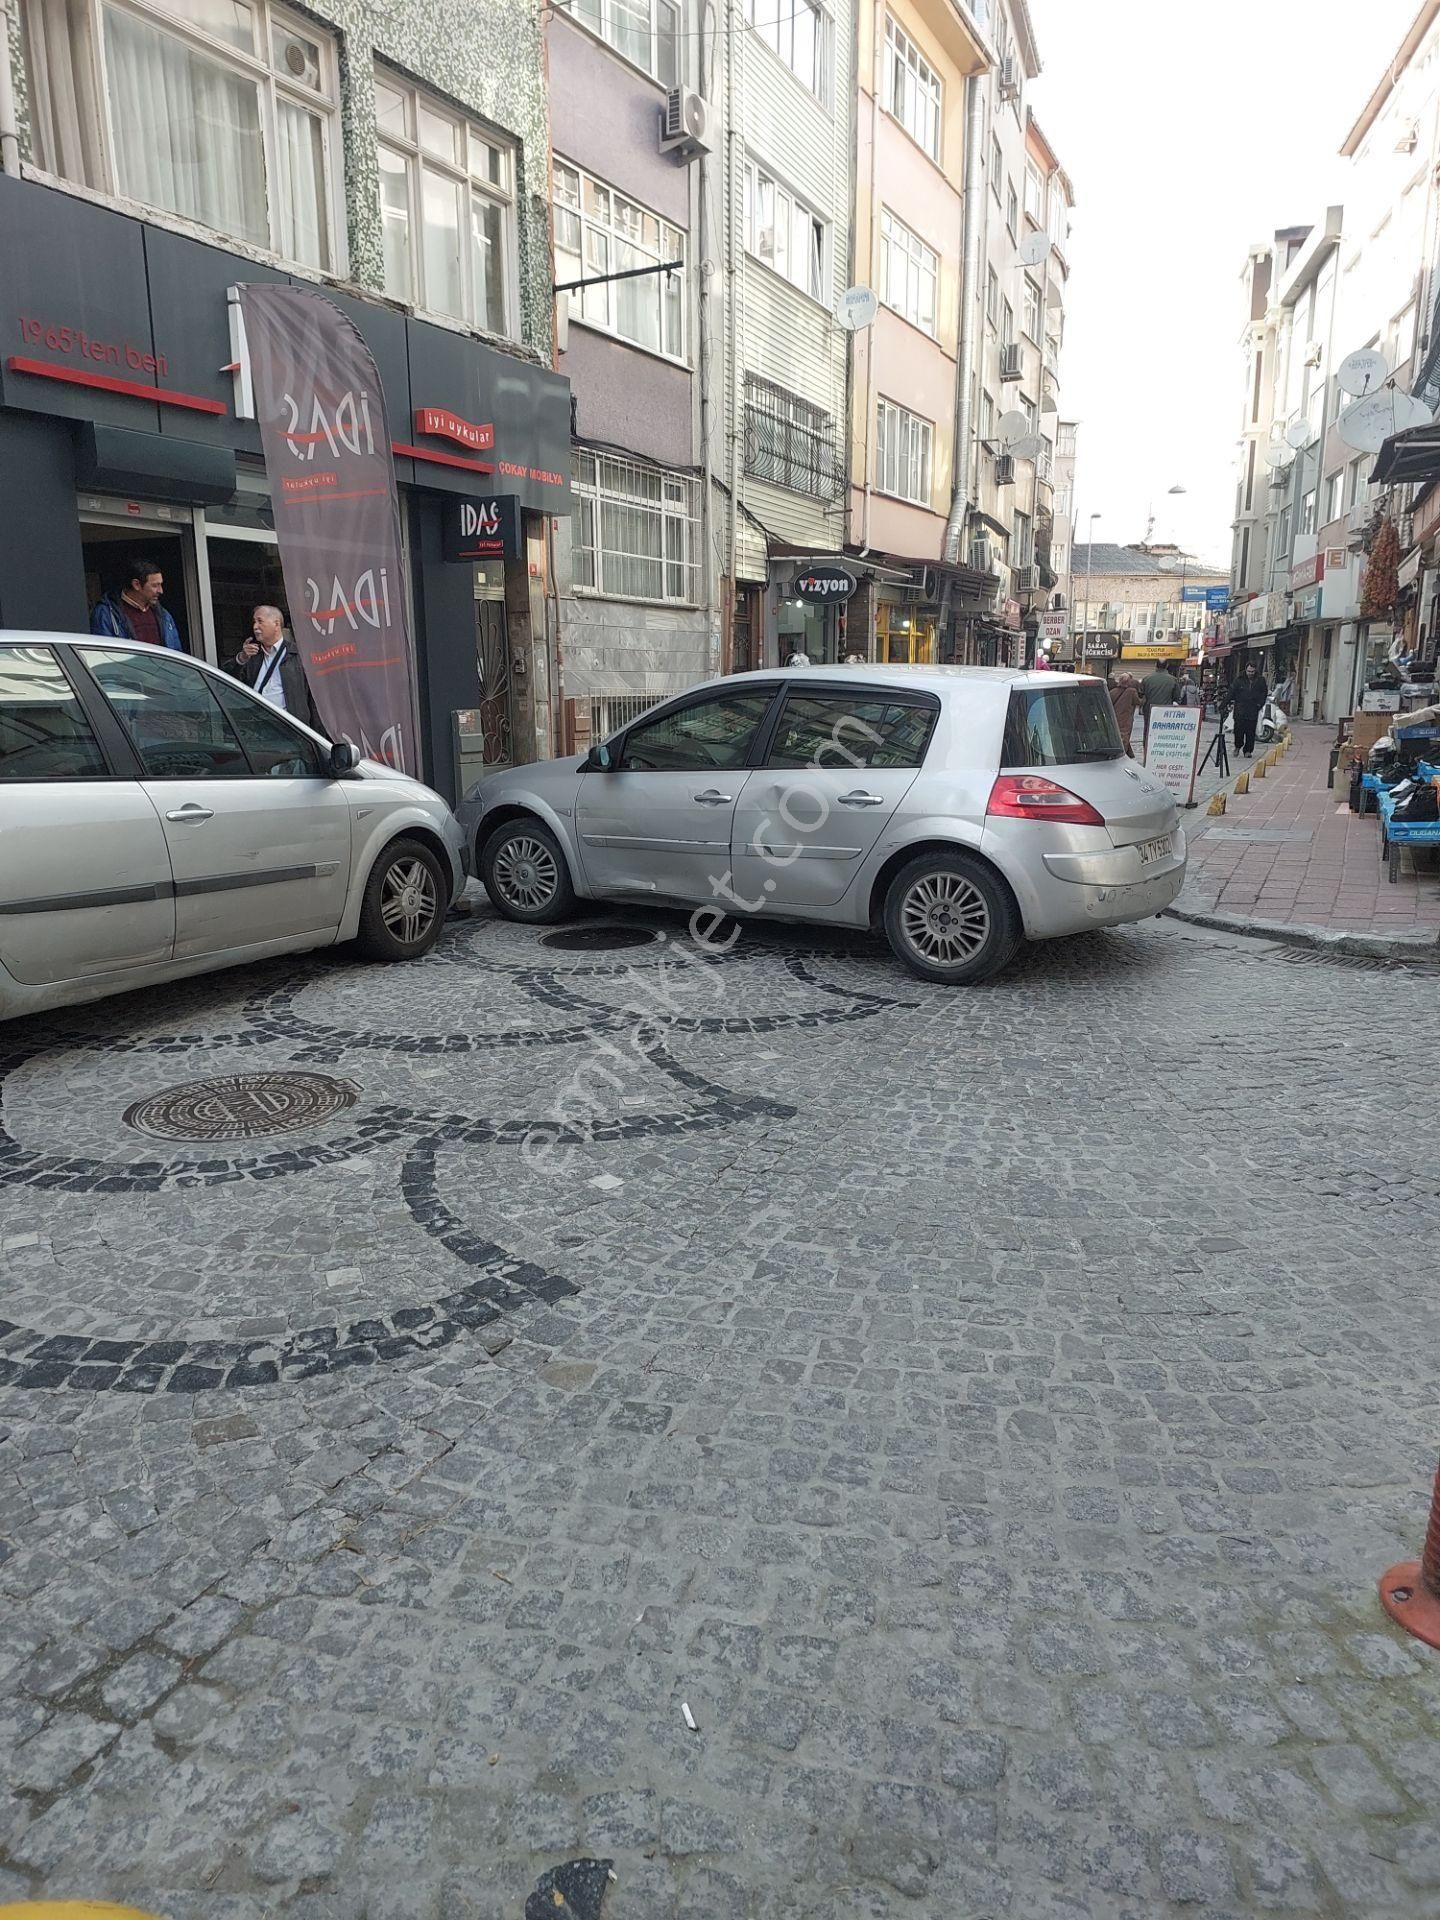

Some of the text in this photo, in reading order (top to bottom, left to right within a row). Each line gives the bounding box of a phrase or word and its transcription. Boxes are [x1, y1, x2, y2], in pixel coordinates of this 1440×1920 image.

[19, 317, 169, 378] 1965'ten beri
[428, 412, 490, 443] iyi uykular
[498, 460, 528, 477] ÇOKAY
[798, 576, 849, 596] vizyon
[1043, 615, 1065, 625] BERBER
[1045, 627, 1061, 636] OZAN
